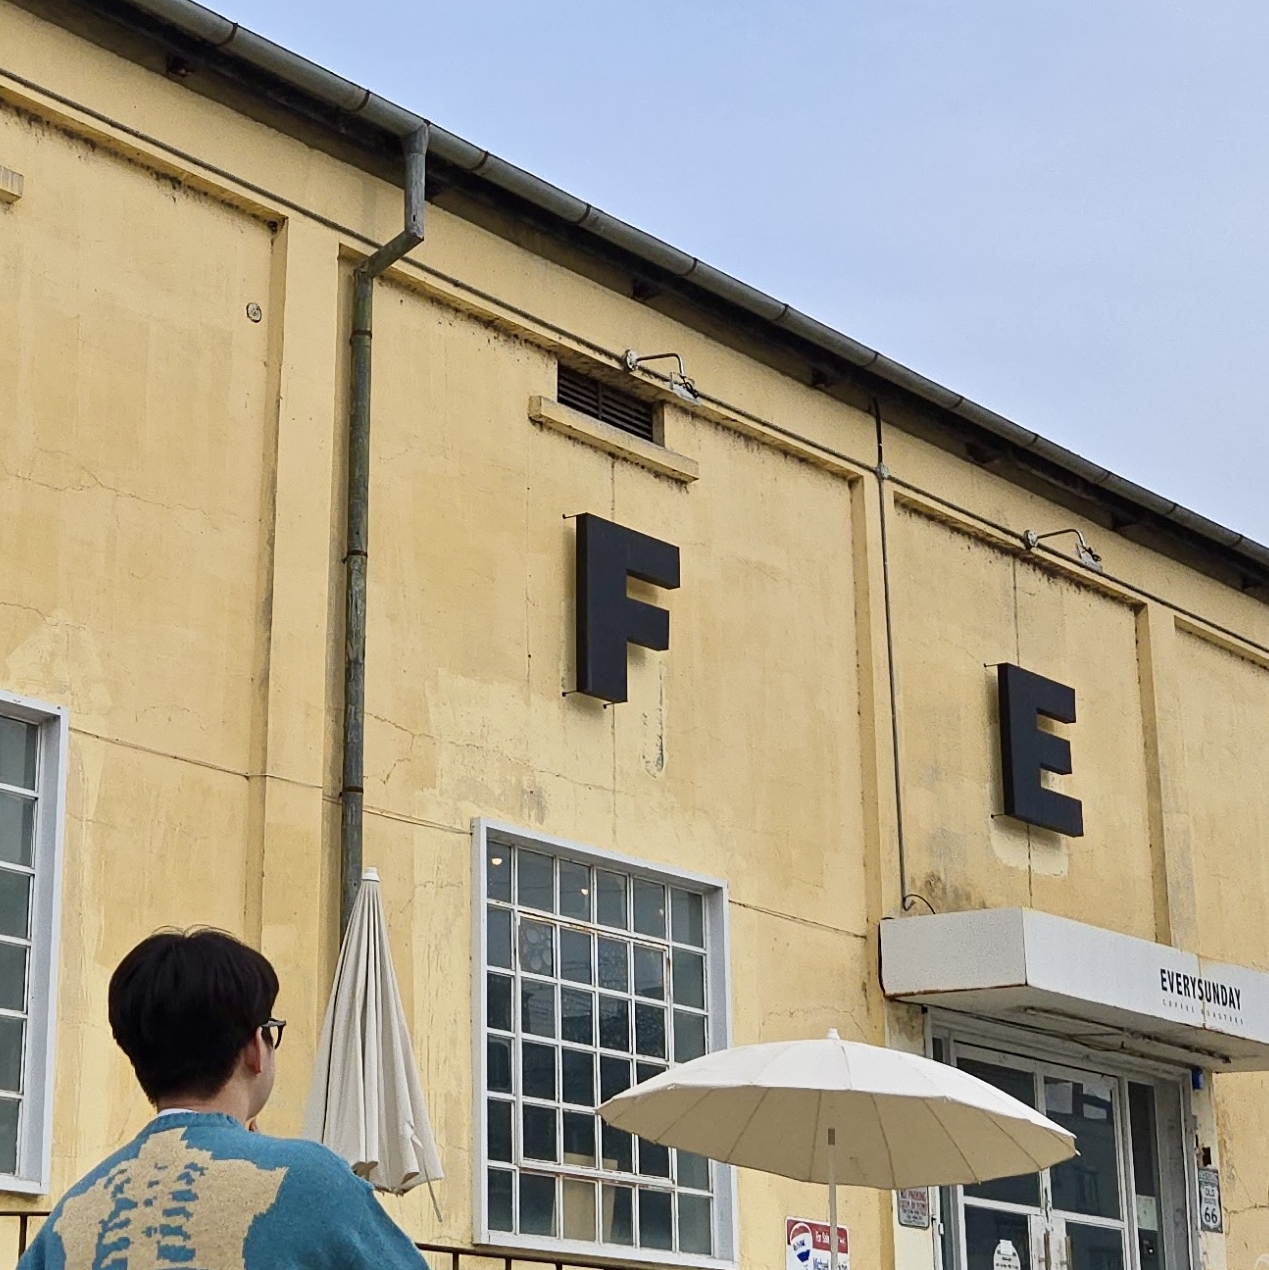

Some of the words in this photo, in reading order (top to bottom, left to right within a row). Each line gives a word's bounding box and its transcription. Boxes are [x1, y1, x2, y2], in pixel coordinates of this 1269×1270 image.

[577, 513, 680, 702] F
[997, 663, 1084, 837] E
[1159, 968, 1241, 1011] EVERYSUNDAY
[1204, 1206, 1218, 1224] 66
